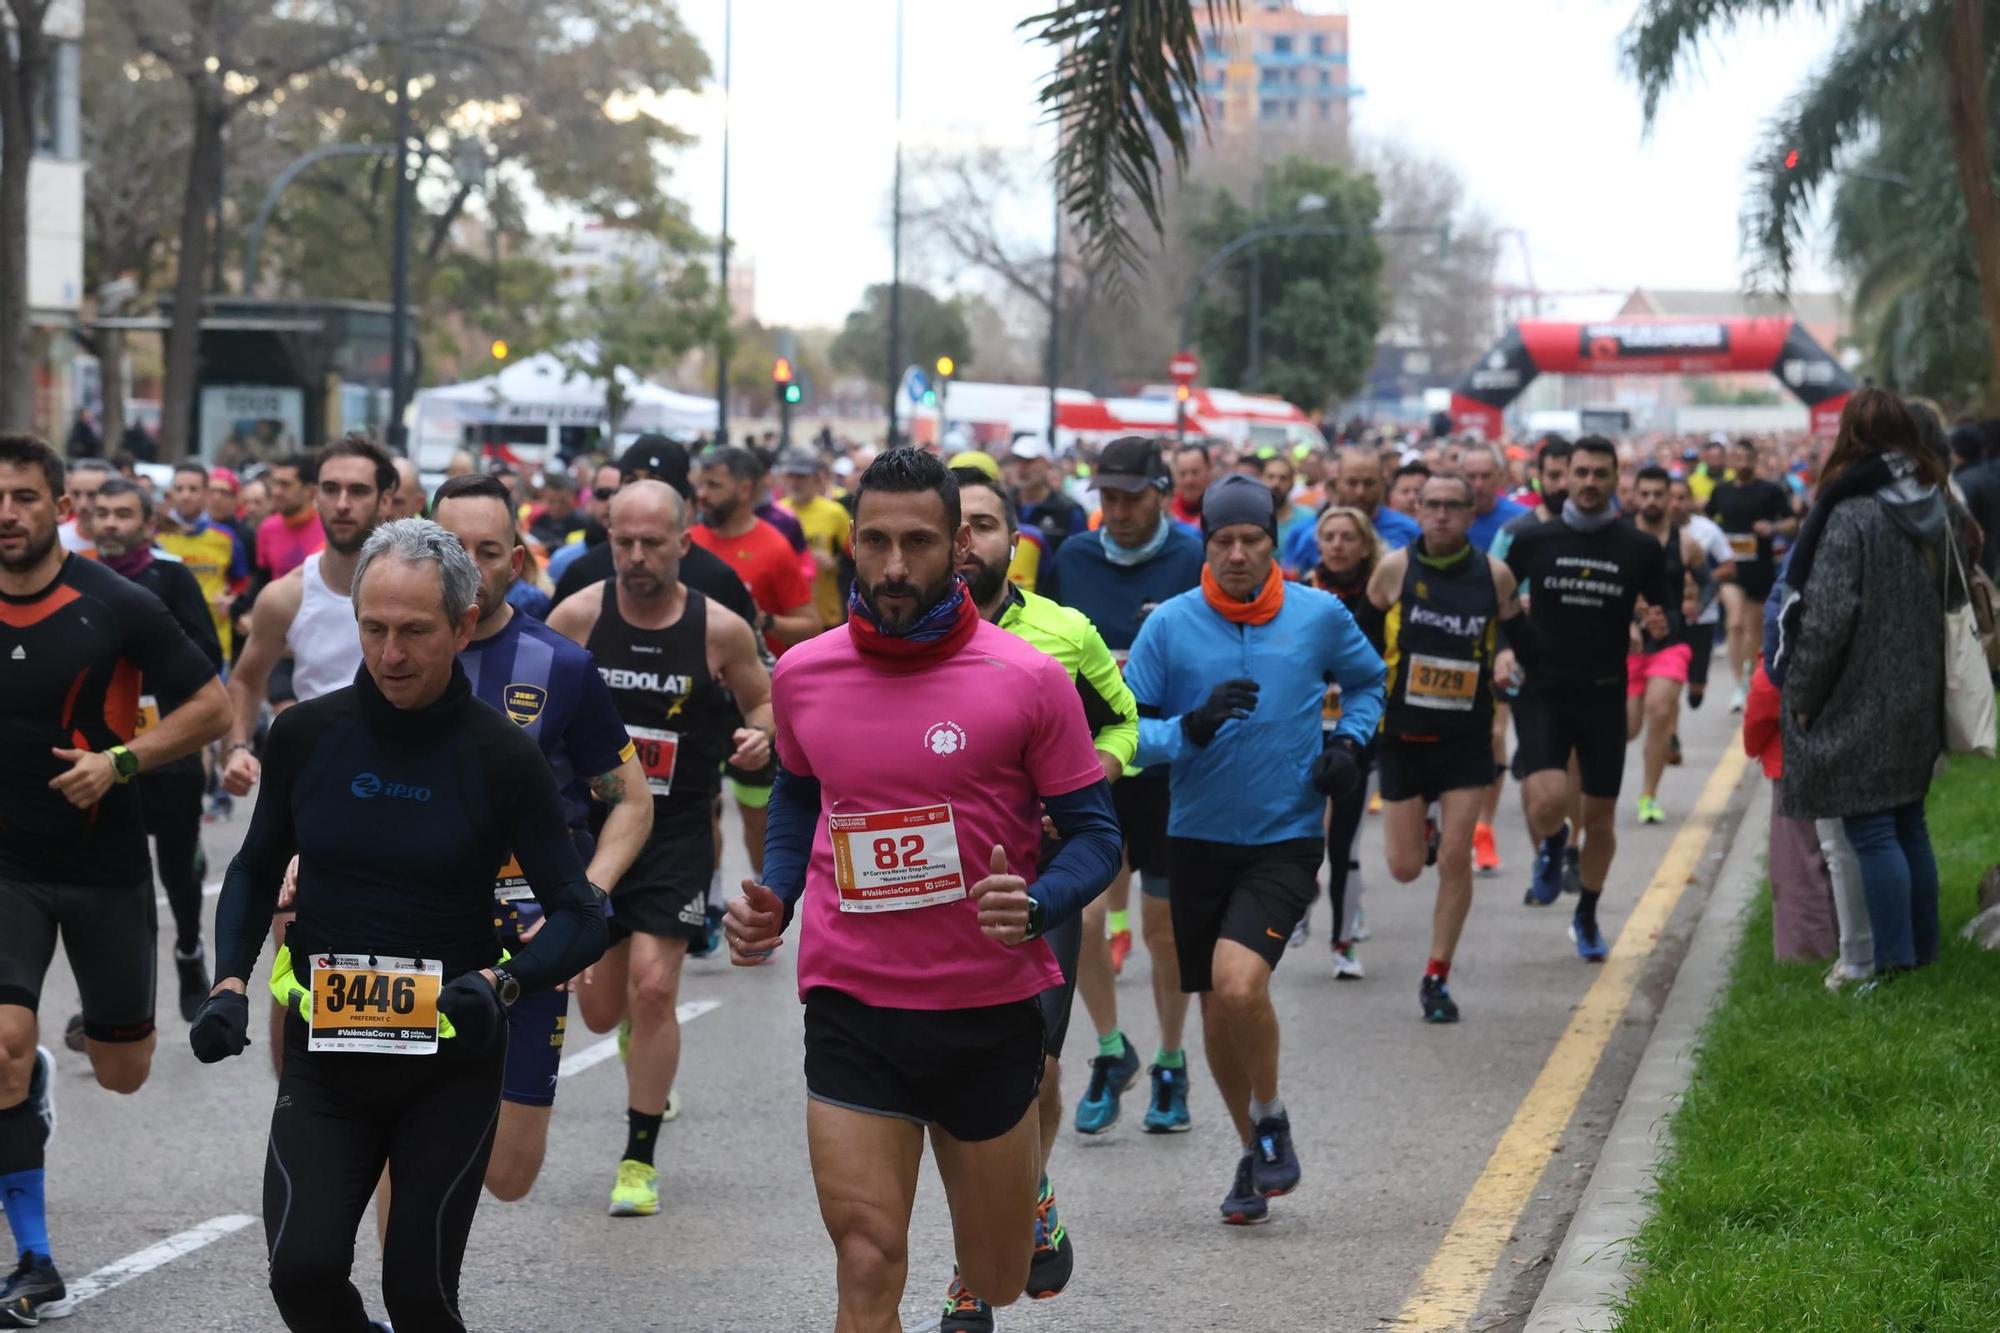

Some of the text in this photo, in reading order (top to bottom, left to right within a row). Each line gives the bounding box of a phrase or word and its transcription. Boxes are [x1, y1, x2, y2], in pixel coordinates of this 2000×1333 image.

[1419, 666, 1464, 691] 3729
[872, 834, 928, 870] 82
[922, 863, 946, 872] Running
[326, 973, 416, 1015] 3446
[350, 1015, 384, 1023] PREFERENT
[337, 1028, 396, 1039] #ValènciaCorre
